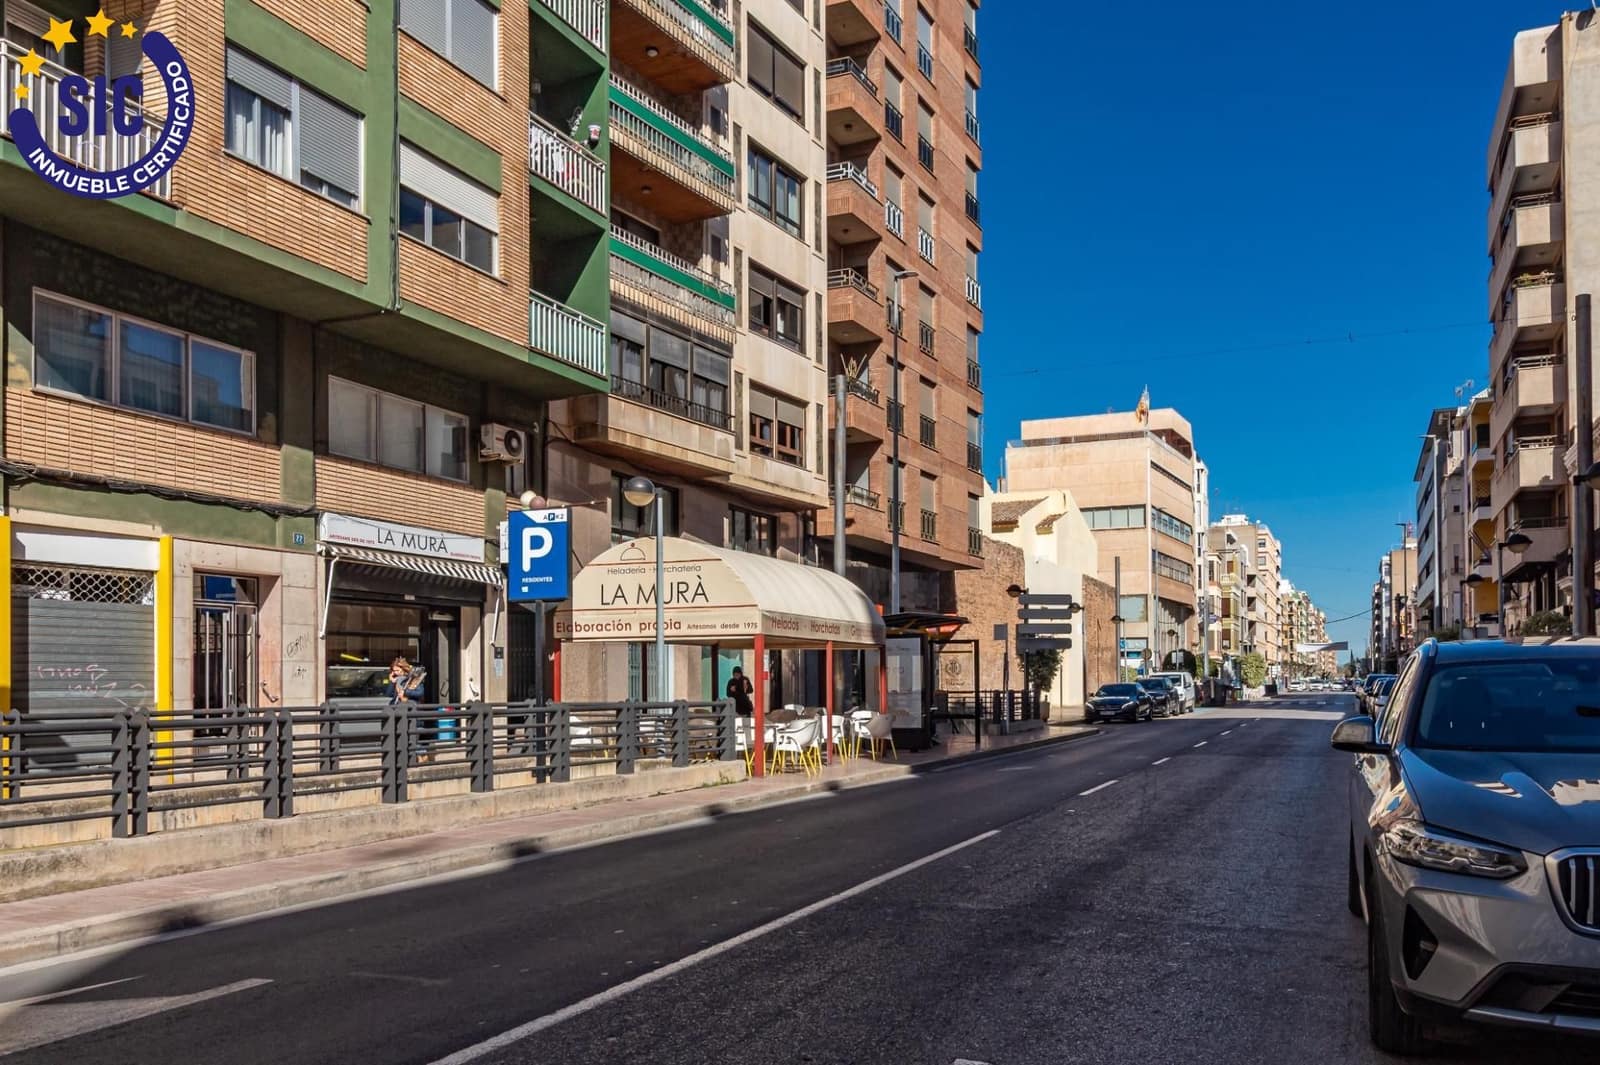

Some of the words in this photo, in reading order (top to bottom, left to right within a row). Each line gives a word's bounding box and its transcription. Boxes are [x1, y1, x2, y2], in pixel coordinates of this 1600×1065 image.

[377, 527, 396, 546] LA
[401, 533, 449, 554] MURÀ
[521, 526, 553, 573] P
[652, 564, 702, 574] Hrchatería
[600, 583, 628, 606] LA
[636, 574, 710, 606] MURÀ
[556, 618, 632, 633] Elaboración
[720, 622, 740, 630] desde
[743, 621, 758, 630] 1975
[771, 616, 800, 631] Helados
